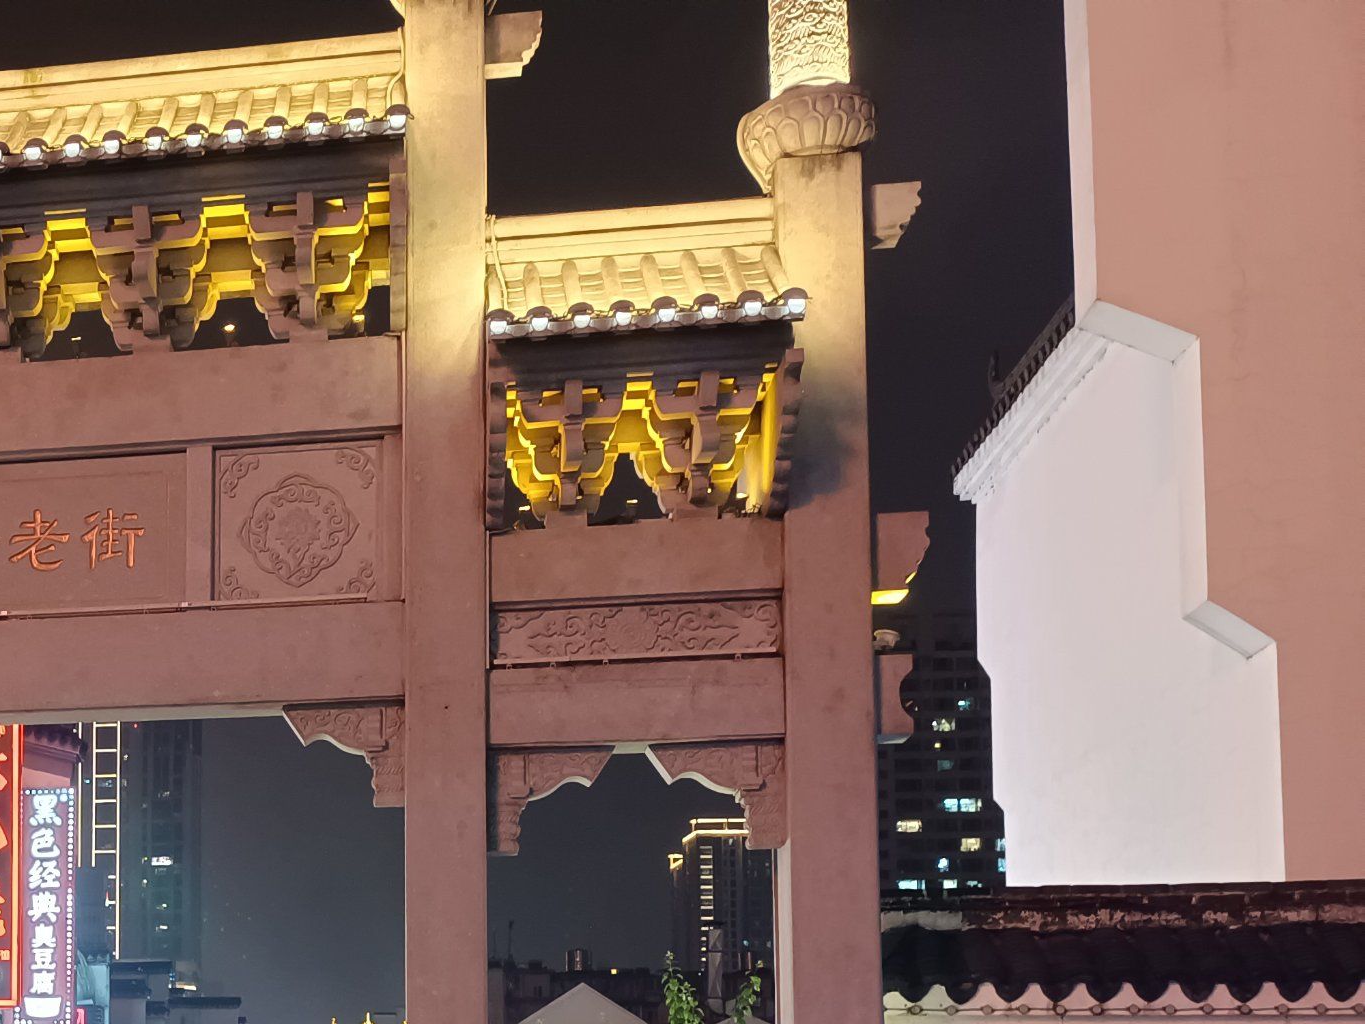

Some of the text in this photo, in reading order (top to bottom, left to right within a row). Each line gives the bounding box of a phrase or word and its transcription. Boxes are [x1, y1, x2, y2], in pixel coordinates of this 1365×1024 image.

[28, 794, 62, 995] 黑色经典臭豆腐
